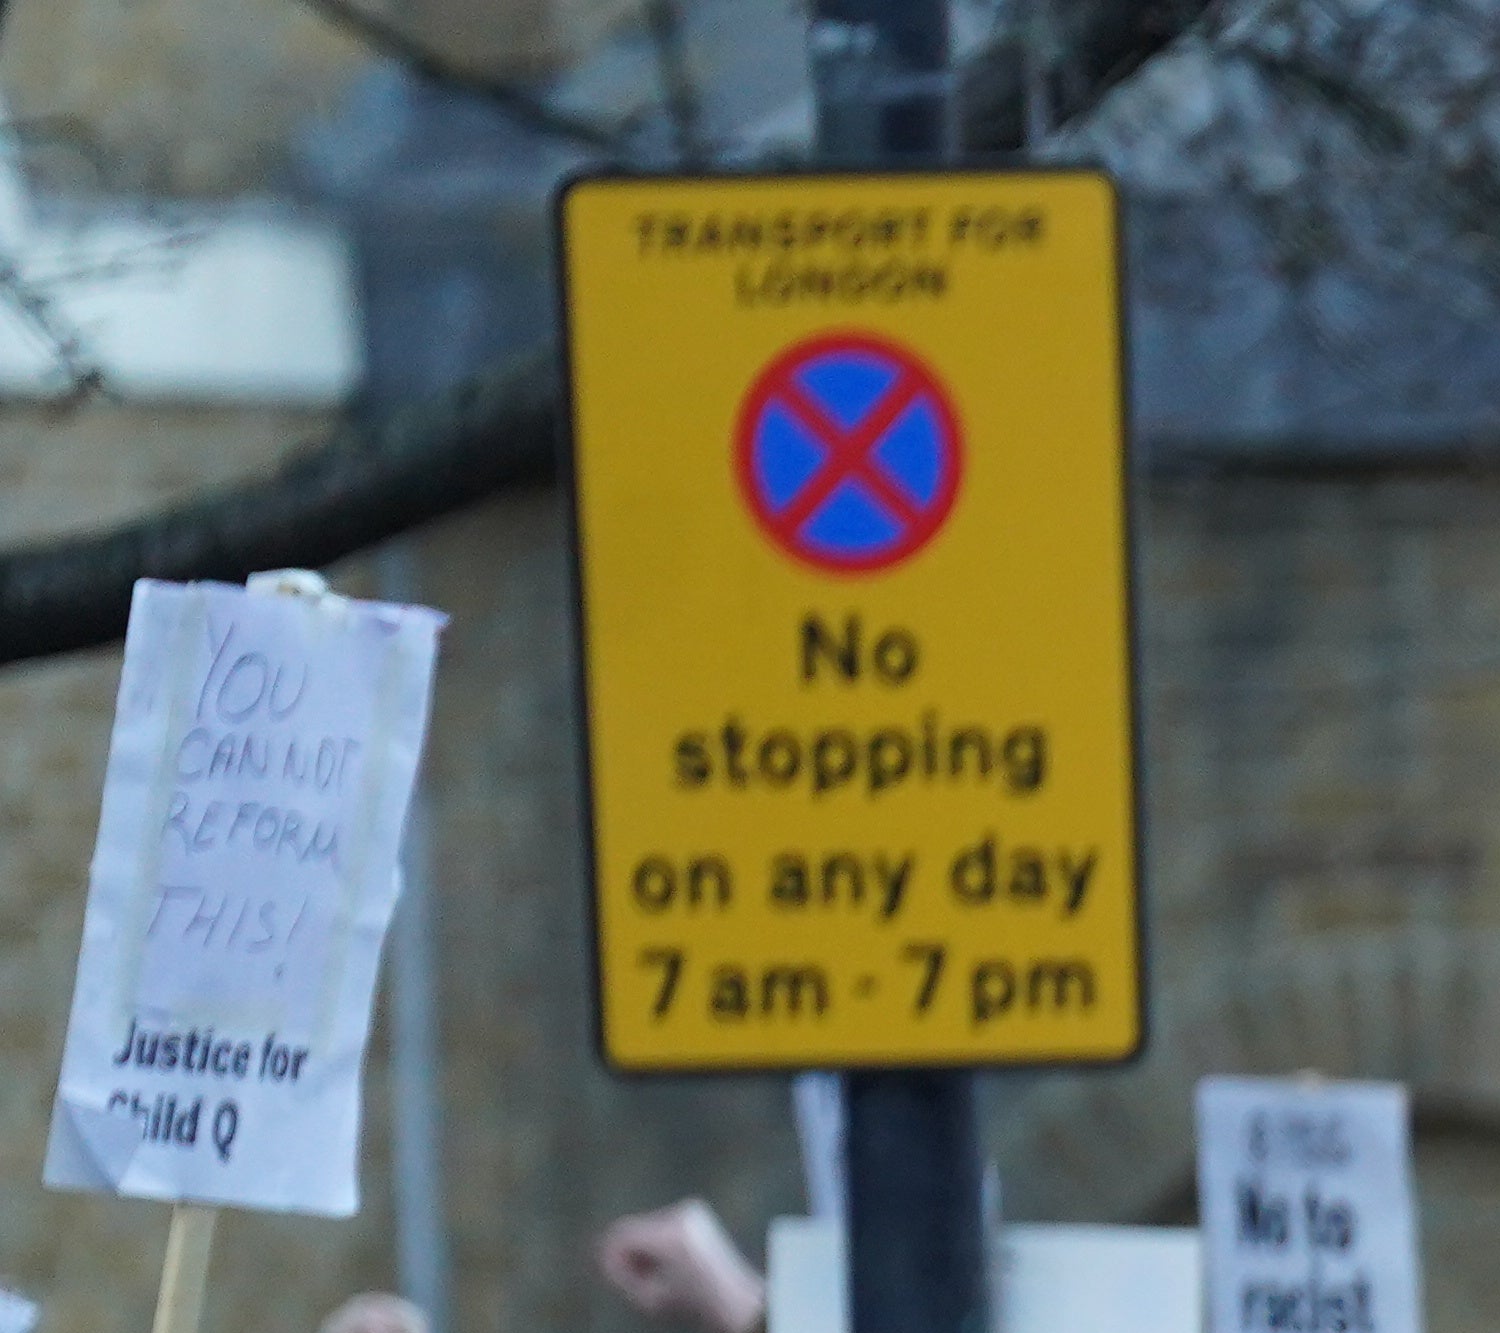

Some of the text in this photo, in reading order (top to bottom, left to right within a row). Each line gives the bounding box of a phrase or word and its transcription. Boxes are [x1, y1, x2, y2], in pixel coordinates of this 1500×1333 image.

[635, 205, 1047, 260] TRANSPORT FOR
[733, 260, 948, 307] LONDON
[197, 620, 309, 722] YOU
[799, 608, 918, 688] No
[671, 710, 1050, 800] stopping
[161, 791, 340, 872] REFORM
[629, 831, 1100, 924] on any day
[112, 1016, 309, 1086] Justice for
[212, 1099, 241, 1163] Q
[1237, 1180, 1356, 1252] No to
